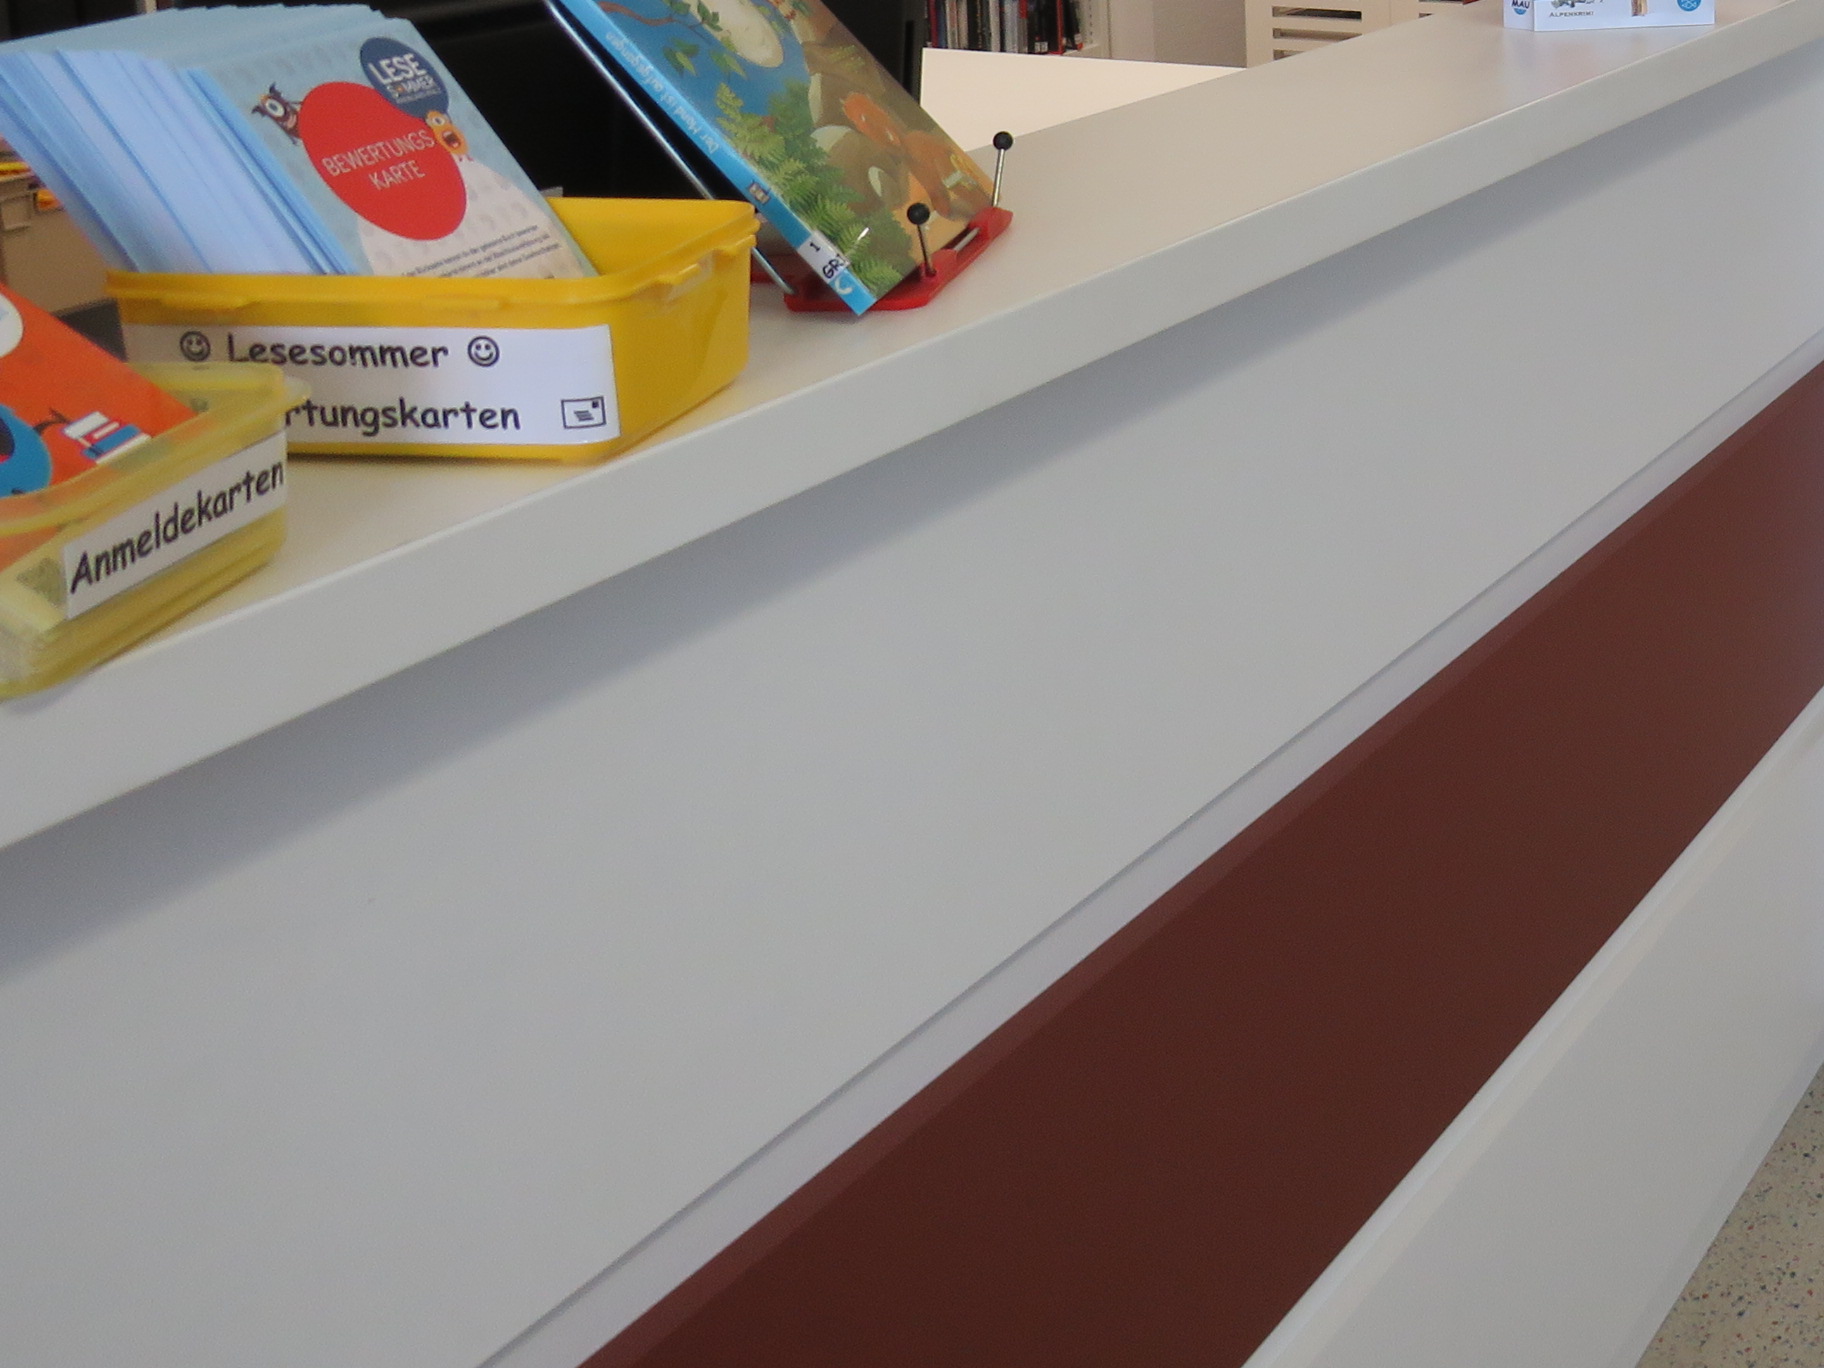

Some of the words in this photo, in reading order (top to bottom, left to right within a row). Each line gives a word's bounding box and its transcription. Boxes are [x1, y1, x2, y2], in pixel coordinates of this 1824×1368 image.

[1511, 0, 1530, 10] MAU
[367, 53, 427, 86] LESE
[320, 128, 436, 178] BEWERTUNGS
[367, 159, 426, 191] KARTE
[227, 332, 449, 369] Lesesommer
[69, 459, 285, 595] Anmeldekarten
